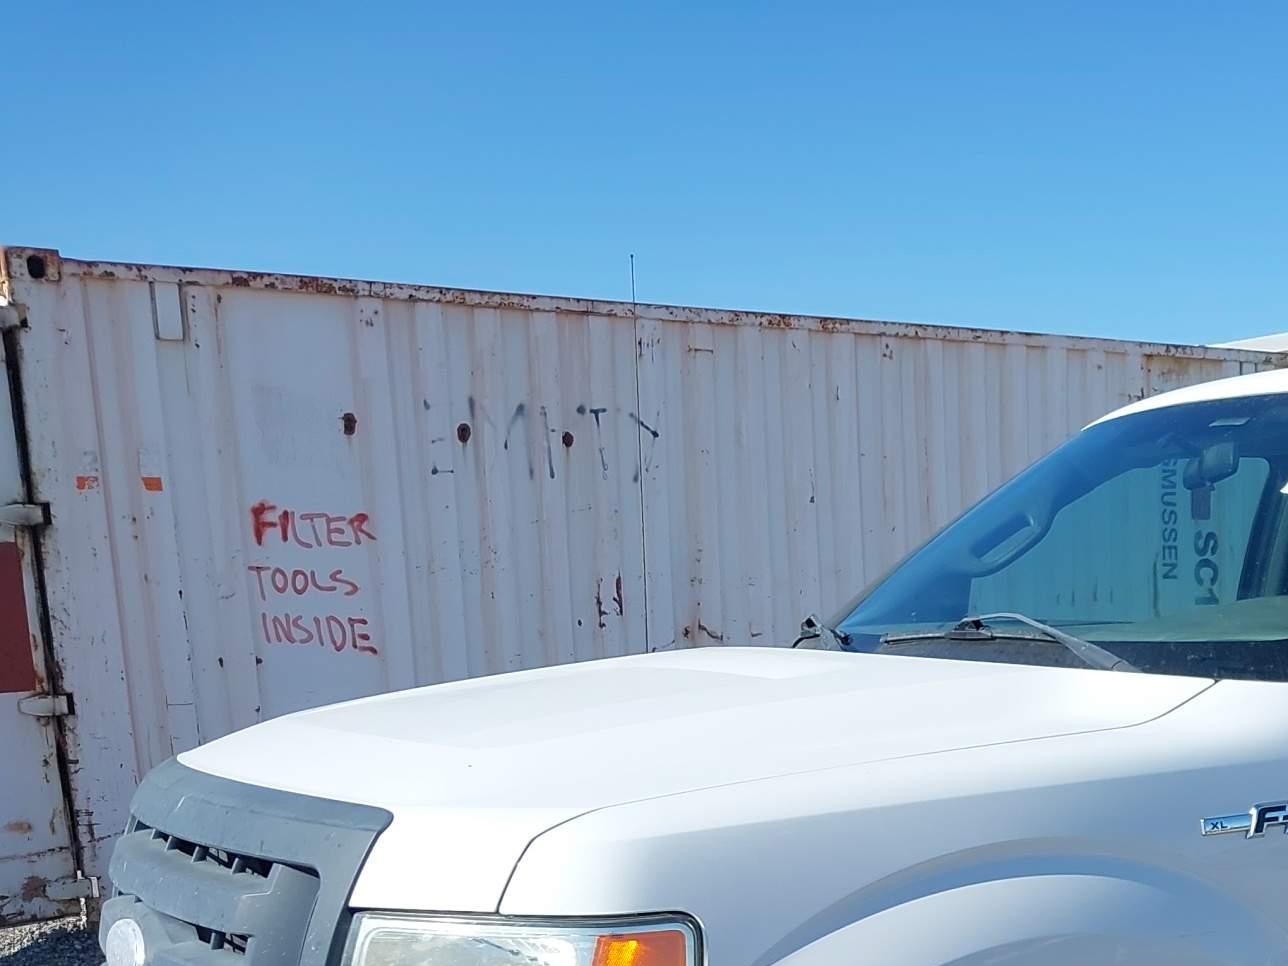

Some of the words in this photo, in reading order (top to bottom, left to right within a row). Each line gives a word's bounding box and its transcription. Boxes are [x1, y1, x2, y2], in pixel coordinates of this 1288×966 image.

[250, 502, 378, 550] FILTER
[247, 564, 360, 601] TOOLS
[261, 612, 378, 655] INSIDE
[1210, 821, 1229, 830] XL
